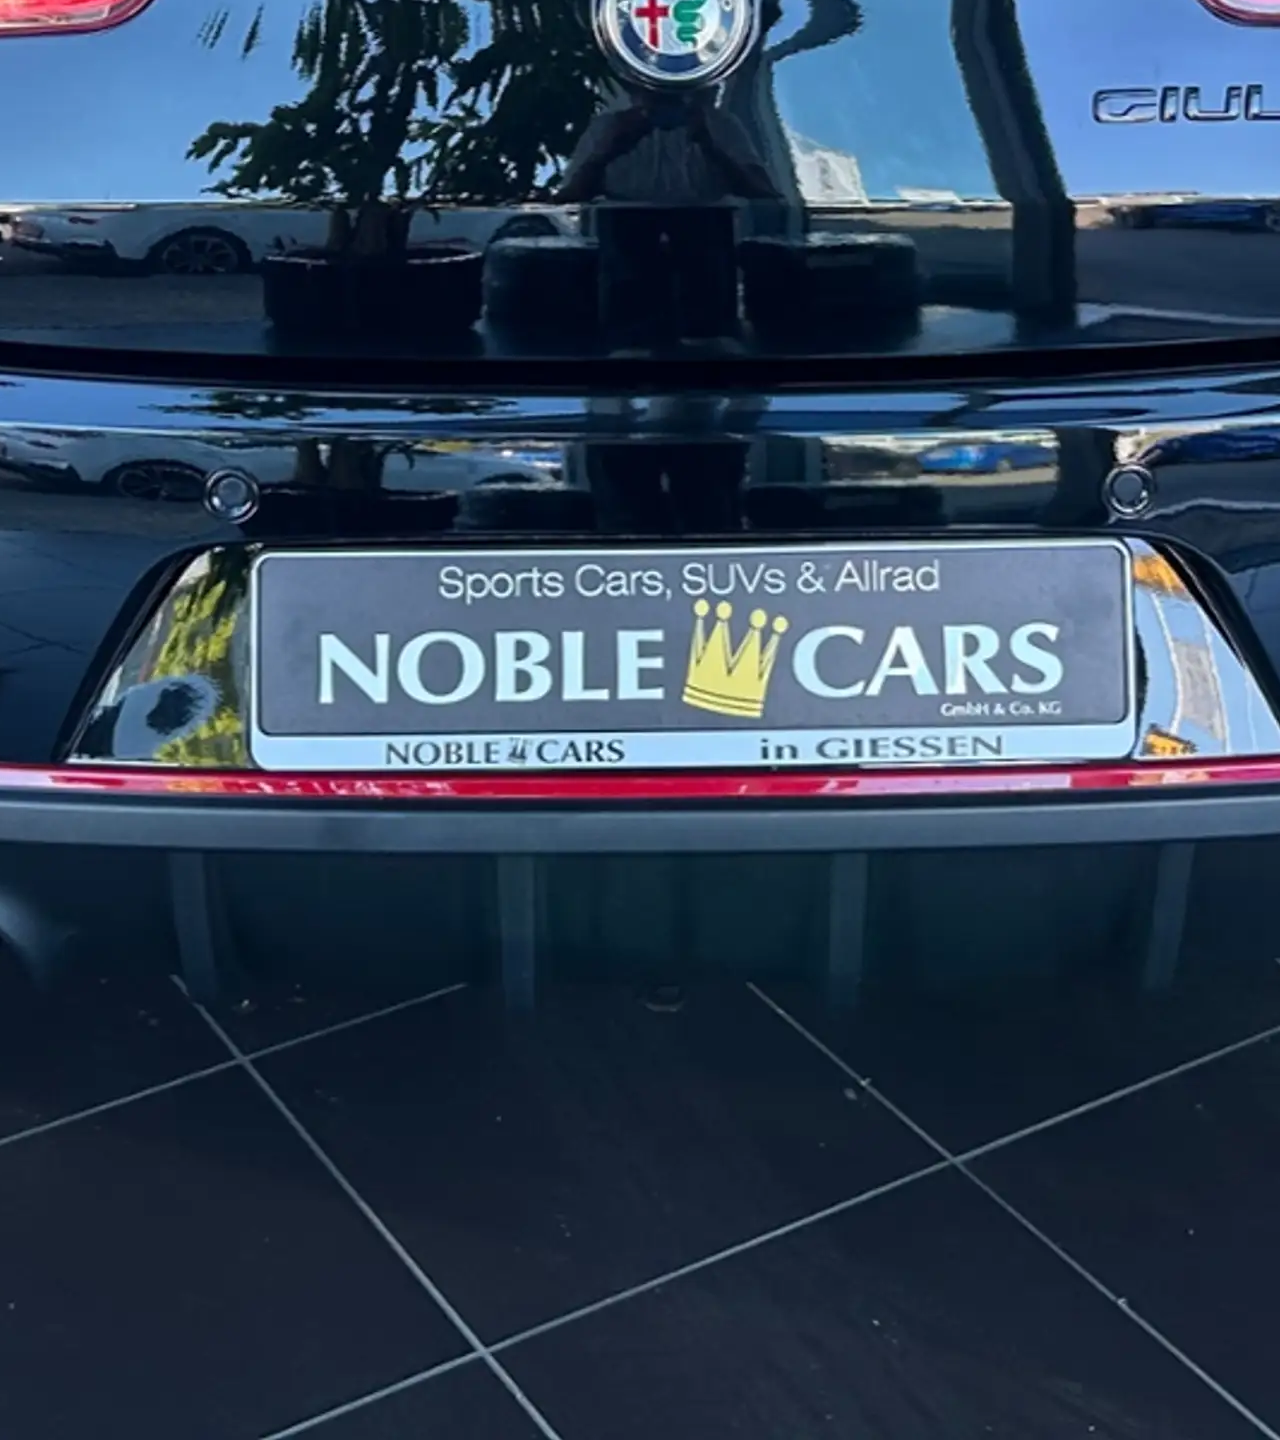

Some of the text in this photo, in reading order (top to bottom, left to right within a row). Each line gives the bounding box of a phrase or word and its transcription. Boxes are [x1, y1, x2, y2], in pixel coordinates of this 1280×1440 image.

[438, 559, 940, 605] Sports Cars, SUVs & Allrad
[318, 622, 1064, 705] NOBLE CARS
[385, 739, 626, 766] NOBLE CARS
[760, 735, 1002, 760] in GIESSEN
